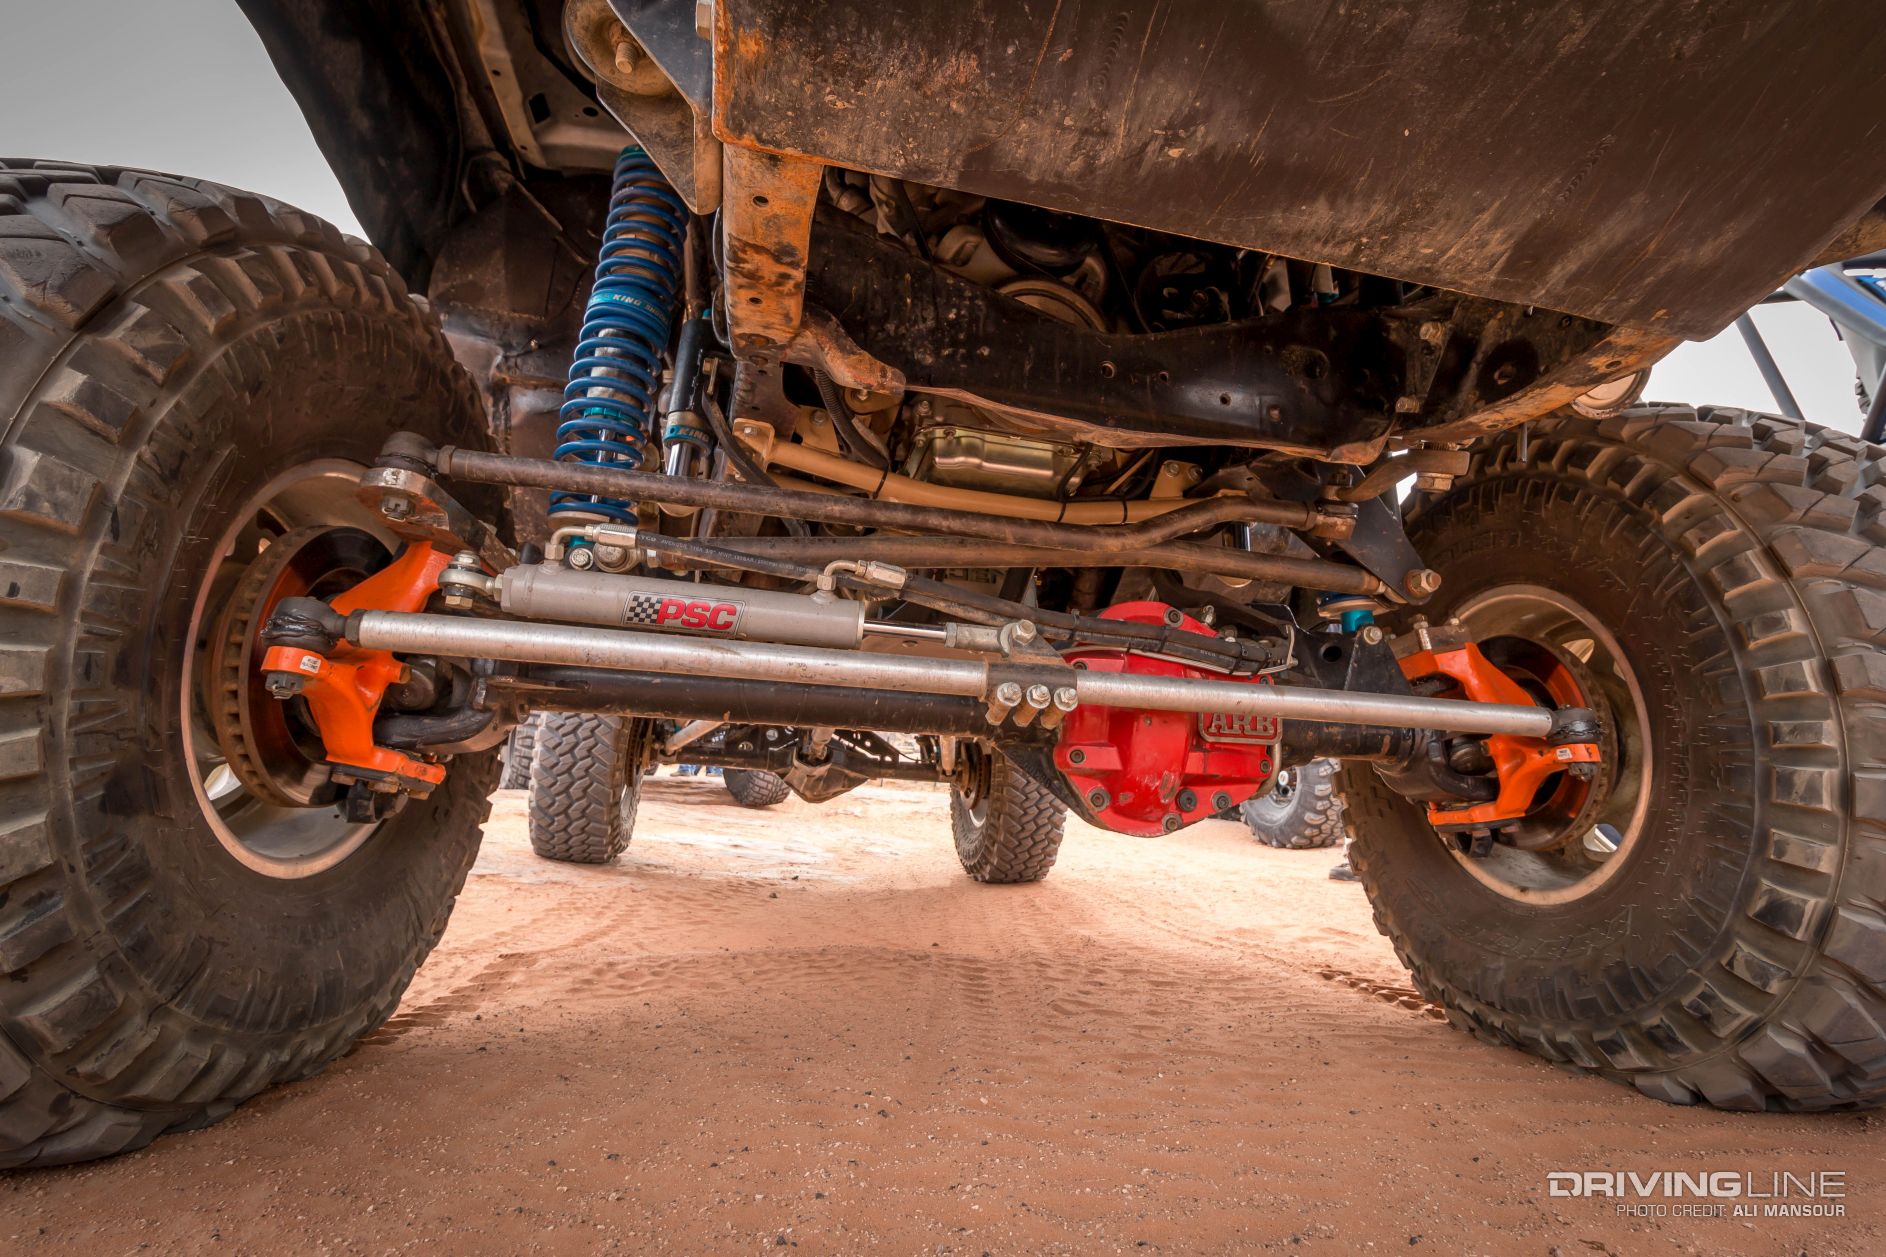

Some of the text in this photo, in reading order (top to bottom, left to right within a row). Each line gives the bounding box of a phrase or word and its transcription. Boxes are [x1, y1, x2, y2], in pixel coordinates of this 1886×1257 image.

[612, 293, 641, 306] KING
[656, 598, 737, 631] PSC
[1207, 712, 1274, 736] ARB
